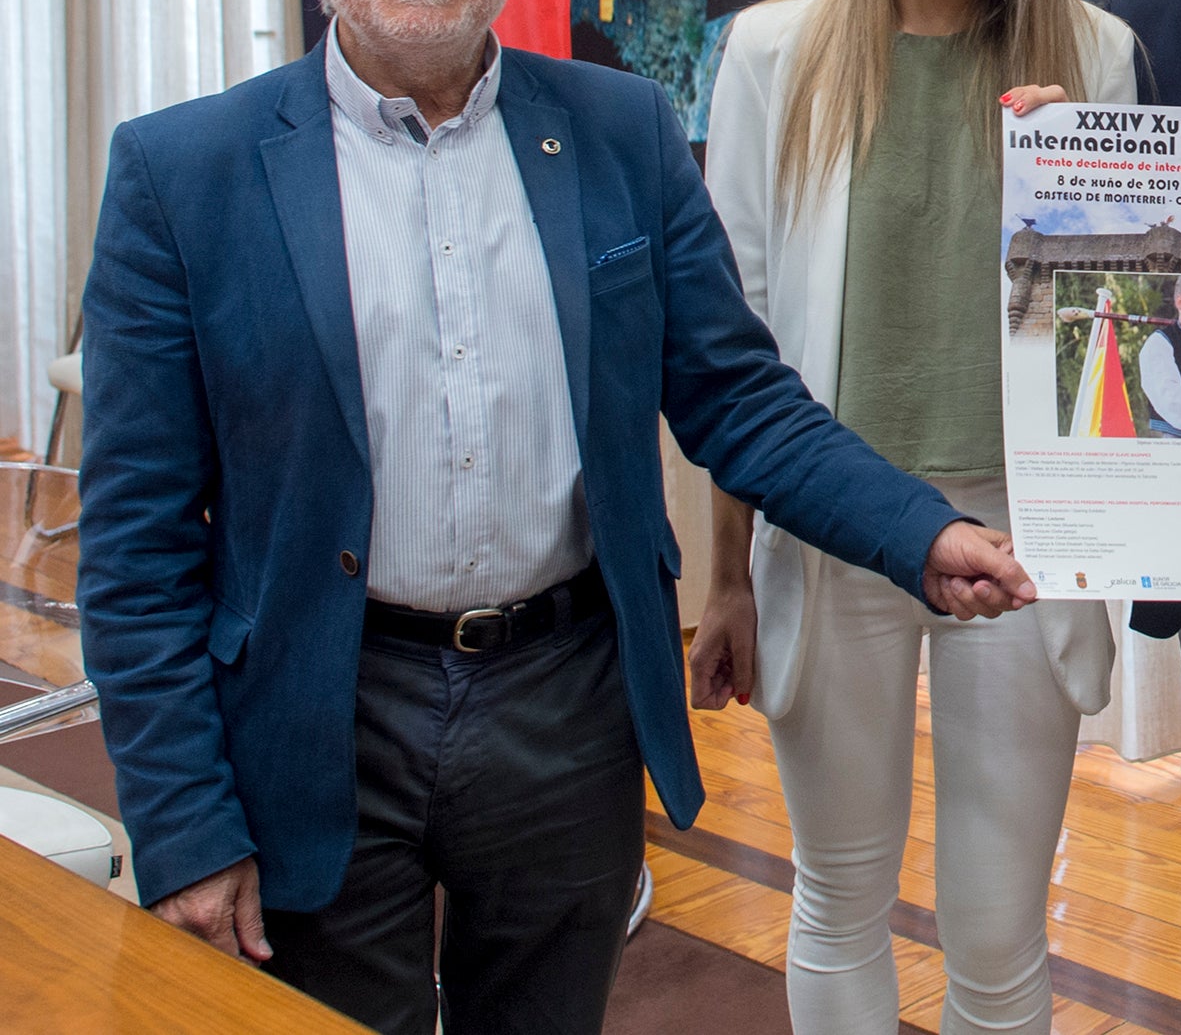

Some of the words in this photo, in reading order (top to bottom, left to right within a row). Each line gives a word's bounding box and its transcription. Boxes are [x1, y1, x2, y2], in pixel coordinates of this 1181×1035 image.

[1076, 110, 1144, 132] XXXIV
[1010, 130, 1176, 155] Internacional
[1036, 156, 1073, 168] Evento
[1077, 158, 1134, 170] declarado
[1138, 161, 1152, 171] de
[1057, 175, 1065, 186] 8
[1070, 176, 1086, 187] de
[1091, 177, 1122, 189] xuño
[1127, 178, 1144, 189] de
[1148, 179, 1180, 191] 2019
[1034, 190, 1082, 201] CASTELO
[1086, 192, 1101, 202] DE
[1104, 193, 1166, 204] MONTERREI
